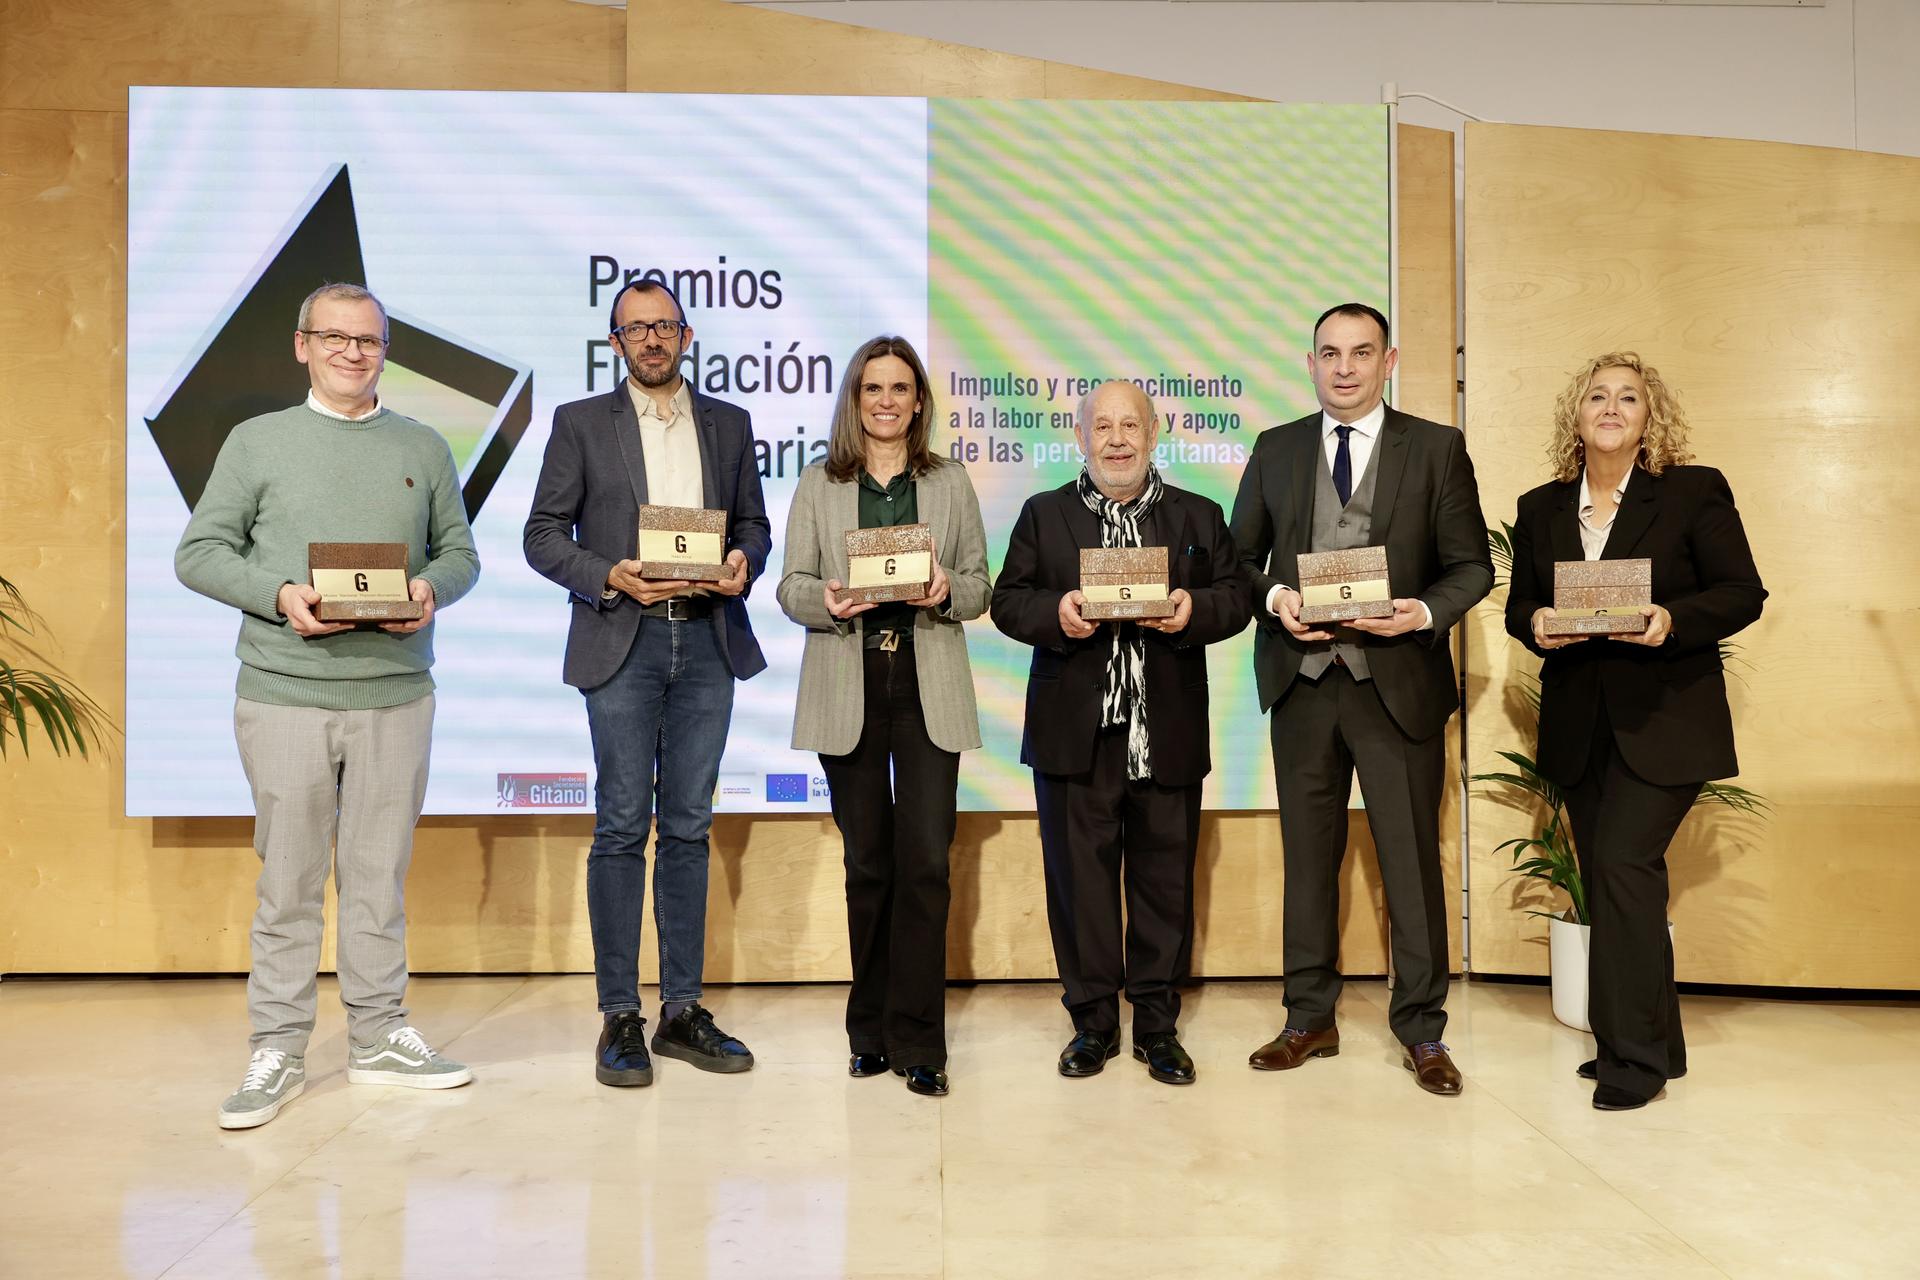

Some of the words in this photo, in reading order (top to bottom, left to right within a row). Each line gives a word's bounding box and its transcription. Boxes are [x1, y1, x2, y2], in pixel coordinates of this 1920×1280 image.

[587, 339, 832, 394] Fdación
[951, 371, 1039, 401] Impulso
[1047, 377, 1059, 401] y
[1066, 373, 1242, 398] reccimiento
[949, 412, 961, 429] a
[968, 407, 985, 429] la
[993, 407, 1044, 429] labor
[1050, 412, 1074, 429] en
[1165, 412, 1176, 434] y
[1183, 412, 1240, 434] apoyo
[950, 436, 979, 463] de
[989, 436, 1024, 463] las
[1155, 437, 1246, 469] gitanas
[675, 535, 687, 553] G
[884, 558, 896, 576] G
[354, 572, 369, 592] G
[1119, 587, 1131, 600] G
[1340, 585, 1352, 600] G
[530, 784, 585, 805] Gitano
